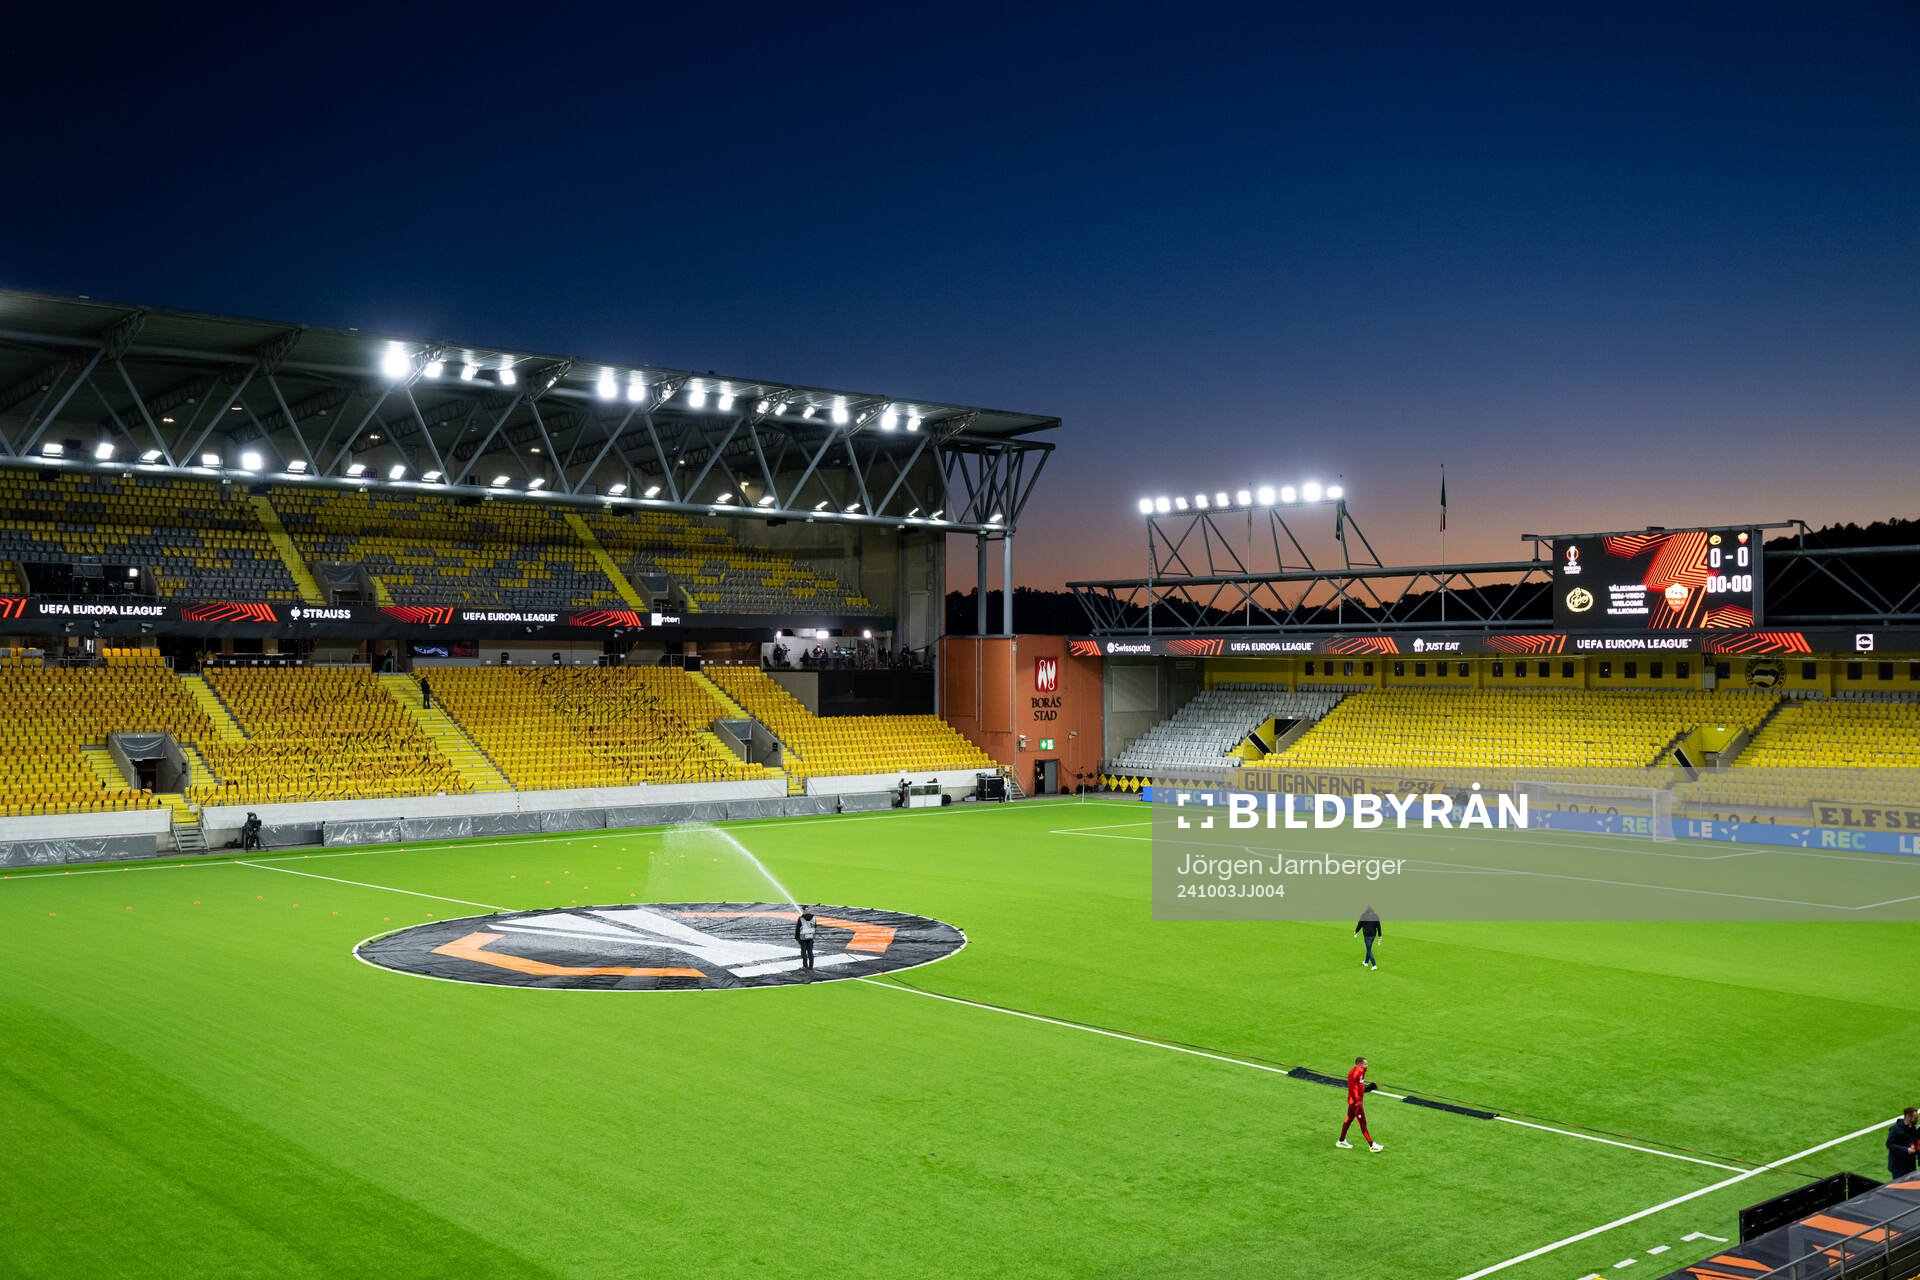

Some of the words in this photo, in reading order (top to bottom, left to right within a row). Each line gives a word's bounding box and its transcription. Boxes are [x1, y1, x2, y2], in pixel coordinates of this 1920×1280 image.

[1710, 548, 1721, 568] 0
[1737, 547, 1748, 567] 0
[1707, 575, 1752, 593] 00:00
[39, 604, 70, 614] UEFA
[73, 605, 118, 615] EUROPA
[120, 606, 163, 616] LEAGUE
[303, 608, 351, 619] STRAUSS
[463, 612, 486, 621] UEFA
[488, 612, 521, 622] EUROPA
[523, 613, 556, 622] LEAGUE
[1115, 643, 1151, 653] Swissquote
[1231, 642, 1250, 651] UEFA
[1252, 642, 1281, 651] EUROPA
[1282, 642, 1312, 651] LEAGUE
[1426, 643, 1444, 651] JUST
[1445, 642, 1460, 651] EAT
[1577, 639, 1603, 649] UEFA
[1605, 639, 1645, 649] EUROPA
[1648, 639, 1689, 649] LEAGUE
[1031, 695, 1061, 708] BORÅS
[1034, 711, 1057, 721] STAD
[1244, 772, 1365, 797] GULIGANERNA
[1688, 820, 1713, 838] LE
[1821, 829, 1867, 850] REC
